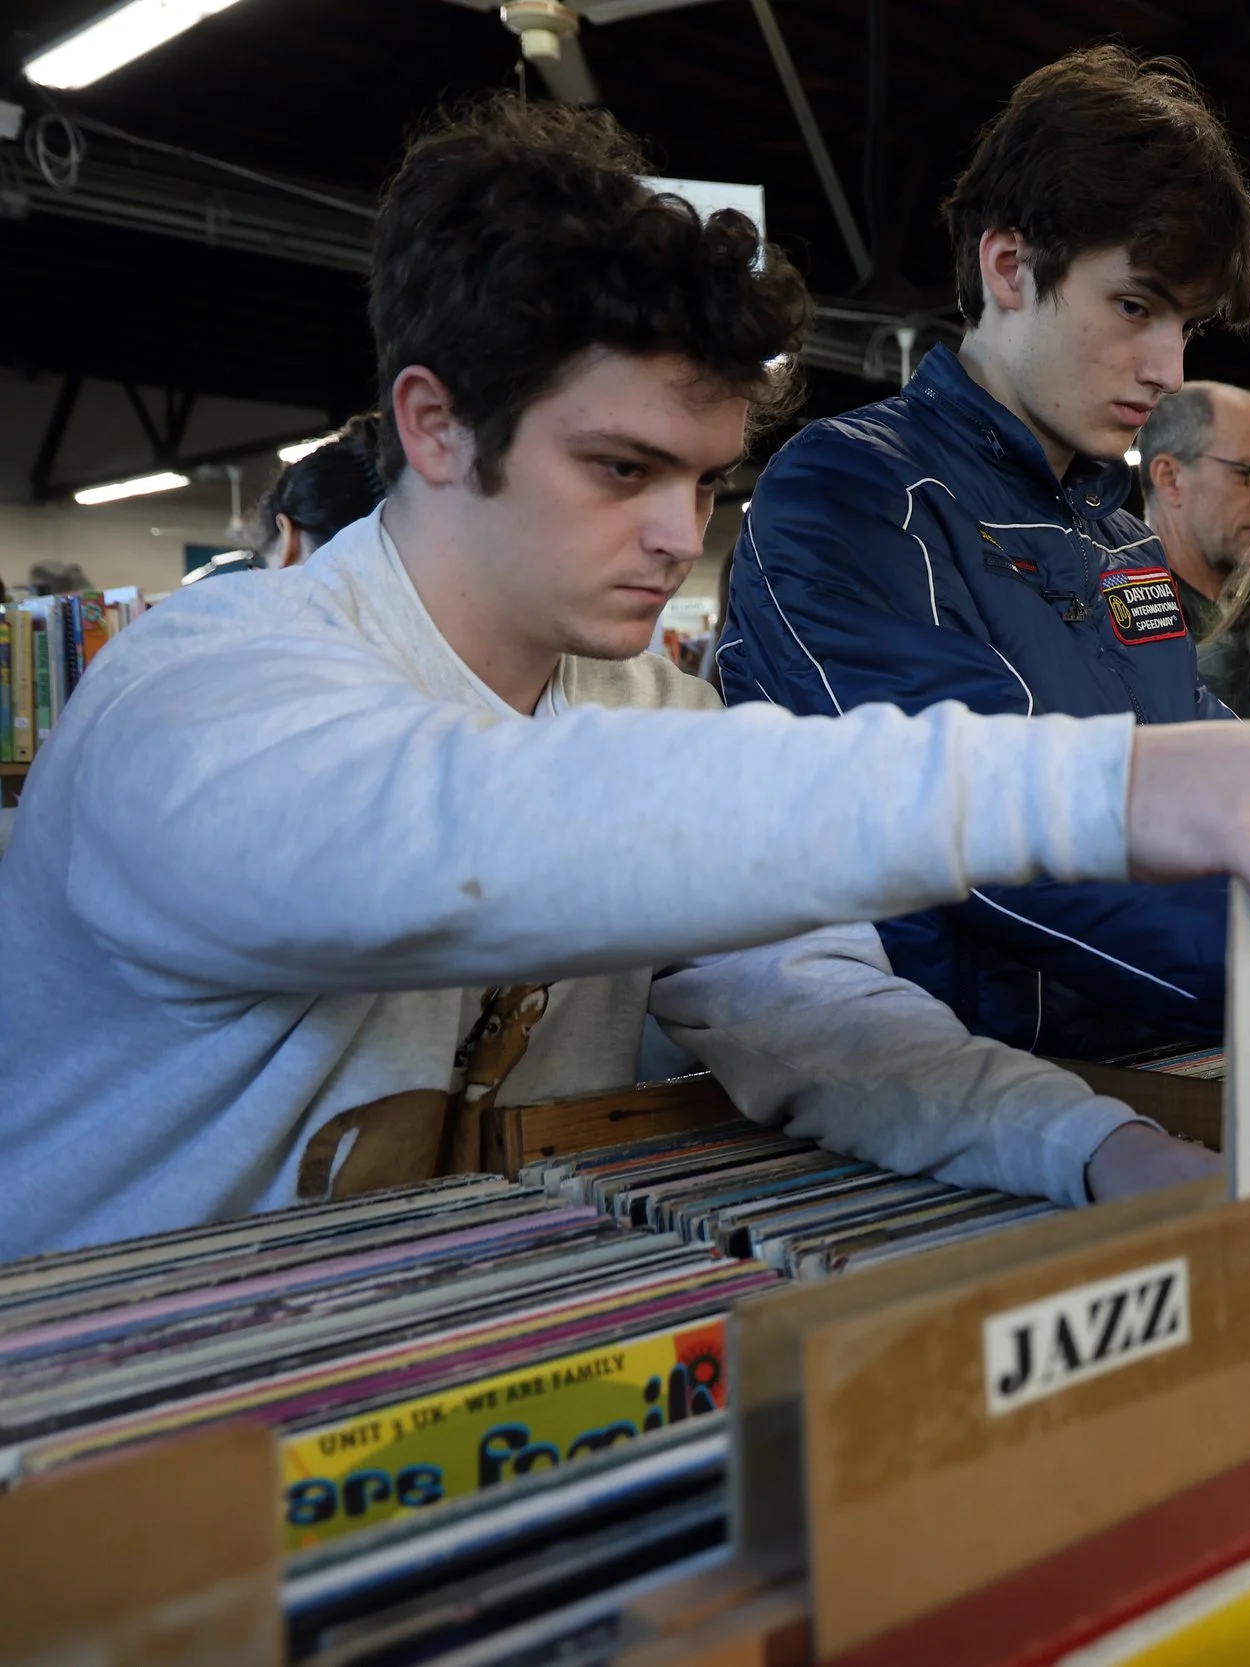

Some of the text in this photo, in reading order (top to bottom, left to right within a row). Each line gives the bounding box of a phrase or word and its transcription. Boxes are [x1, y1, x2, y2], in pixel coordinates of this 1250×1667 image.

[1123, 583, 1175, 604] DAYTONA
[1130, 601, 1180, 618] INTERNATIONAL
[999, 1273, 1179, 1397] JAZZ
[318, 1421, 382, 1457] UNIT
[412, 1402, 450, 1433] UK
[464, 1390, 503, 1414] WE
[506, 1375, 547, 1404] ARE
[551, 1353, 628, 1391] FAMILY
